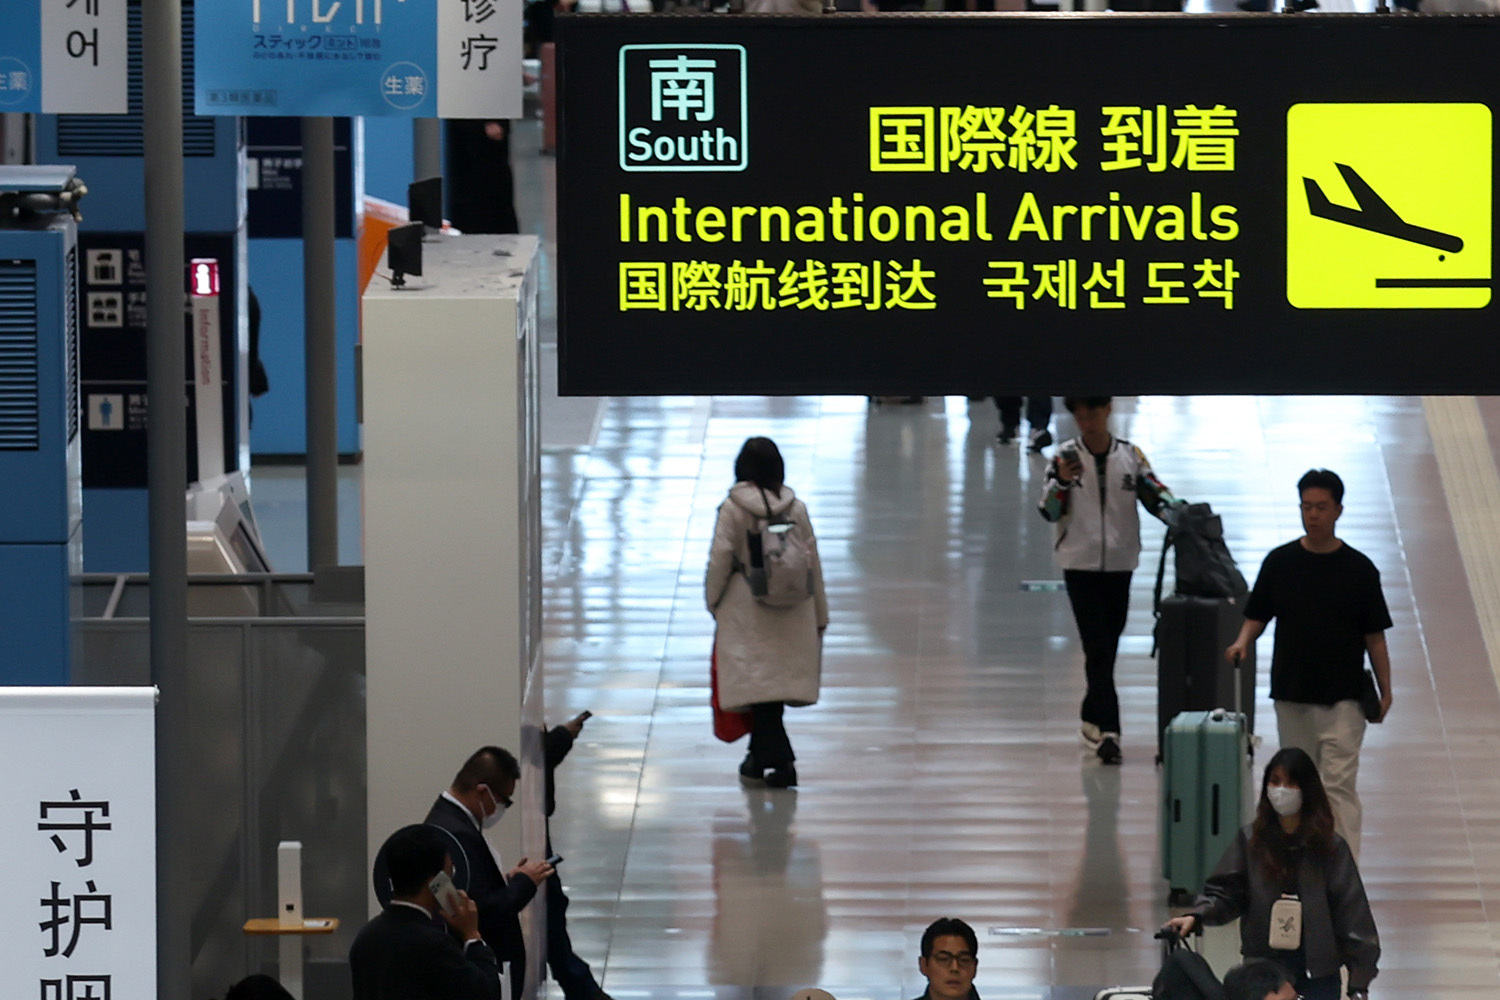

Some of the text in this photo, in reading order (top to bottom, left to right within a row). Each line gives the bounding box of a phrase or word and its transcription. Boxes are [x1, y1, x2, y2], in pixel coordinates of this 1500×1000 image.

[254, 34, 321, 49] スティック
[385, 76, 424, 95] 生薬
[649, 55, 716, 121] 南
[628, 128, 738, 163] South
[869, 104, 1241, 174] 国際線 到着
[619, 192, 1240, 243] International Arrivals
[619, 259, 937, 312] 国際航线到达
[982, 259, 1240, 310] 국제선 도착
[200, 309, 210, 385] Information
